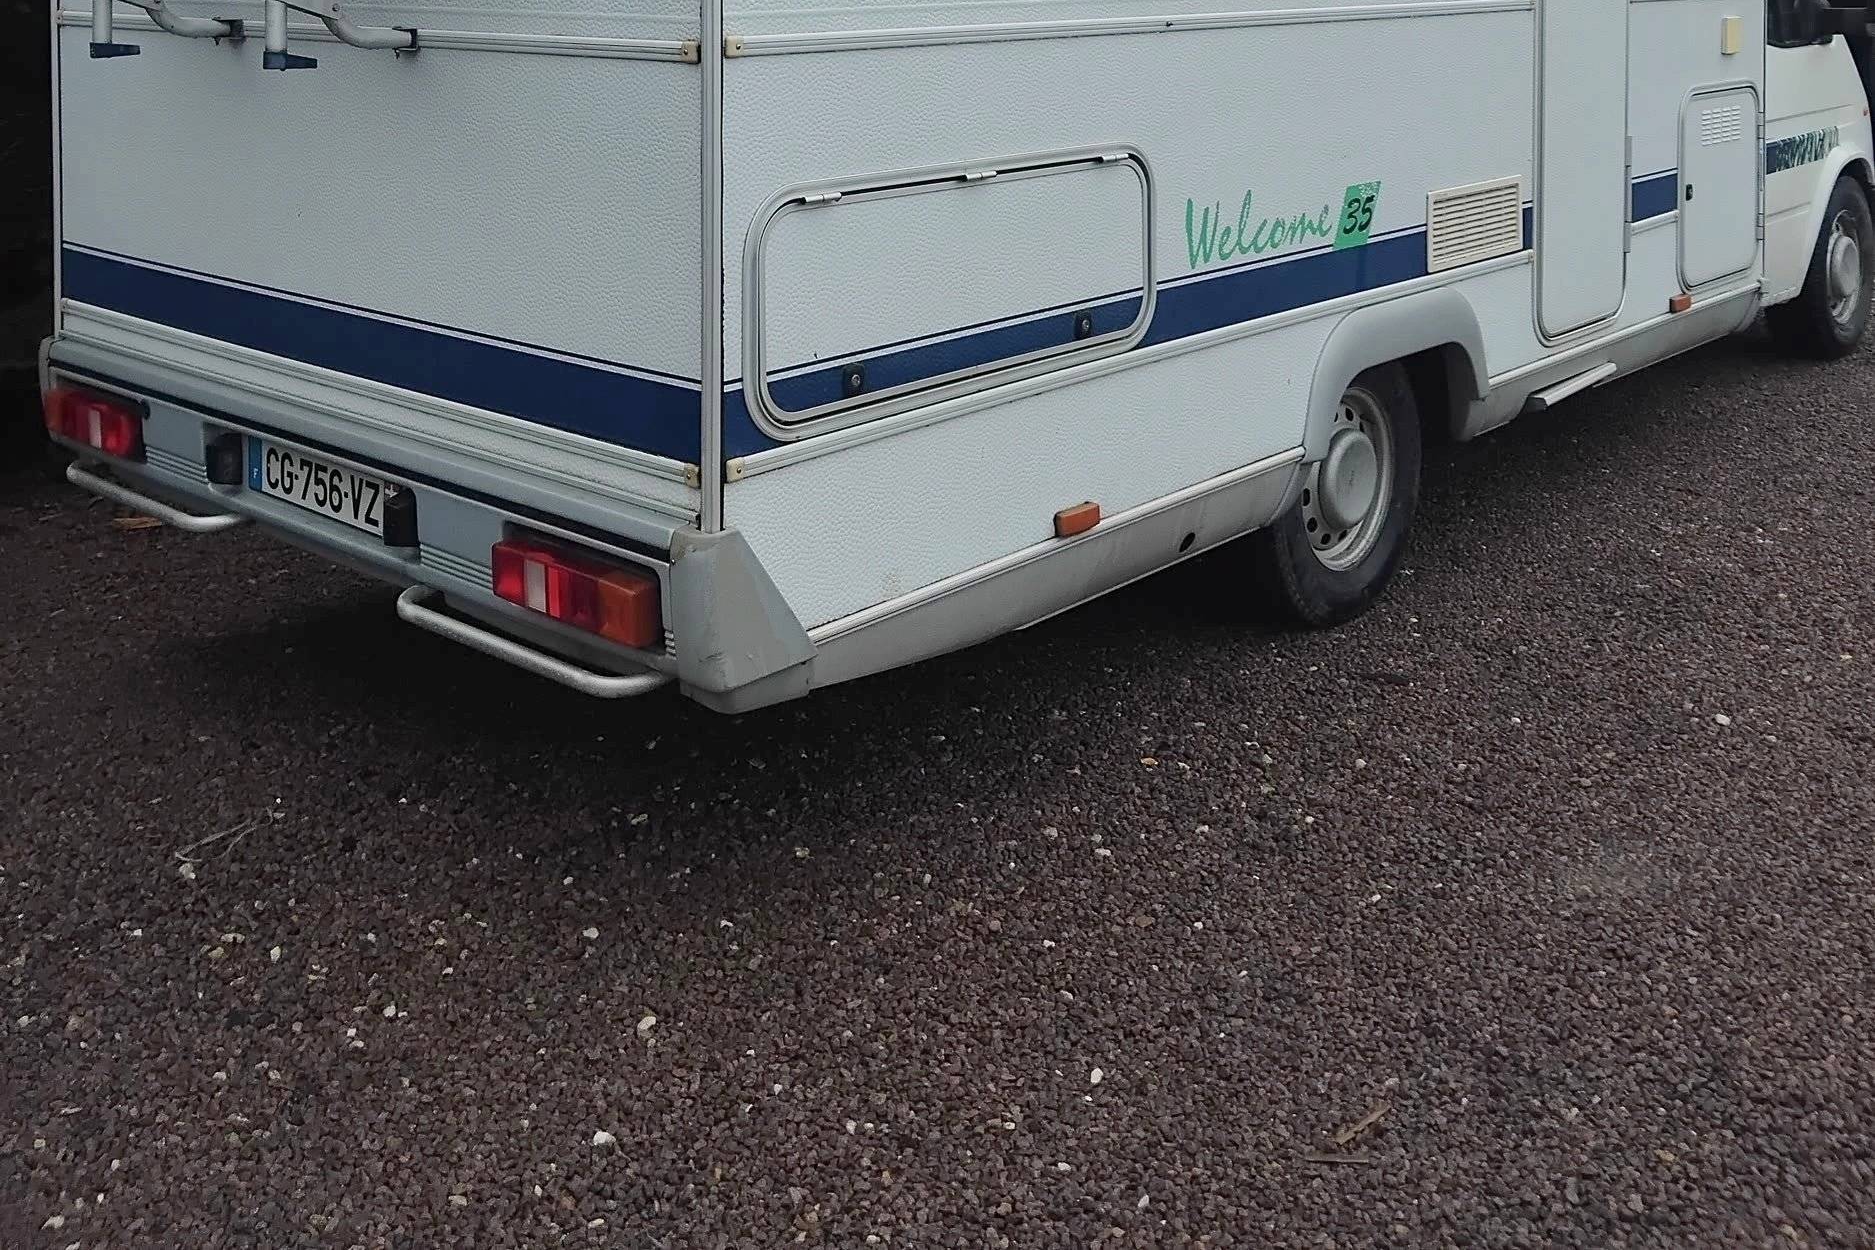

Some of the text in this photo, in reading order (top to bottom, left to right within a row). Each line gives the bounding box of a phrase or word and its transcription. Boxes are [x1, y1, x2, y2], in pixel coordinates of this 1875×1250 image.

[1185, 189, 1375, 269] Welcome 35
[266, 447, 380, 528] CG-756-VZ
